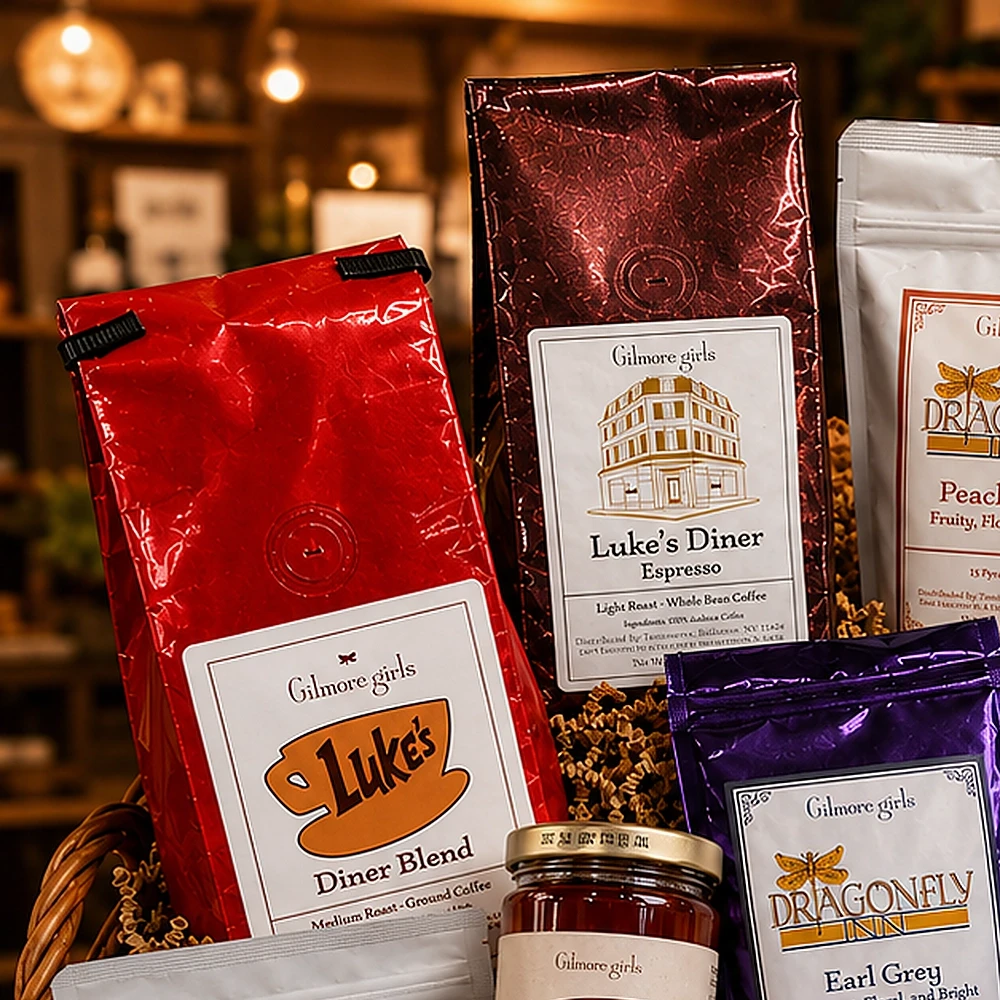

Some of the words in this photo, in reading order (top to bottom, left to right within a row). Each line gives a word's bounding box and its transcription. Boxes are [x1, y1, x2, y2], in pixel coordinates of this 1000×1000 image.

[612, 344, 676, 367] Gilmore
[679, 341, 716, 372] girls
[929, 511, 977, 532] Fruity,
[590, 529, 679, 559] Luke's
[686, 526, 764, 552] Diner
[641, 562, 722, 584] Espresso
[596, 602, 626, 615] Light
[628, 601, 657, 611] Roast
[732, 591, 767, 603] Coffee
[287, 673, 369, 703] Gilmore
[371, 653, 418, 697] girls
[806, 796, 874, 820] Gilmore
[876, 787, 916, 821] girls
[314, 869, 393, 896] Diner
[396, 835, 474, 875] Blend
[405, 891, 451, 910] Ground
[768, 870, 974, 929] DRAGONFLY
[842, 915, 908, 942] INN
[609, 954, 643, 980] girls
[825, 965, 876, 993] Earl
[882, 964, 941, 987] Grey
